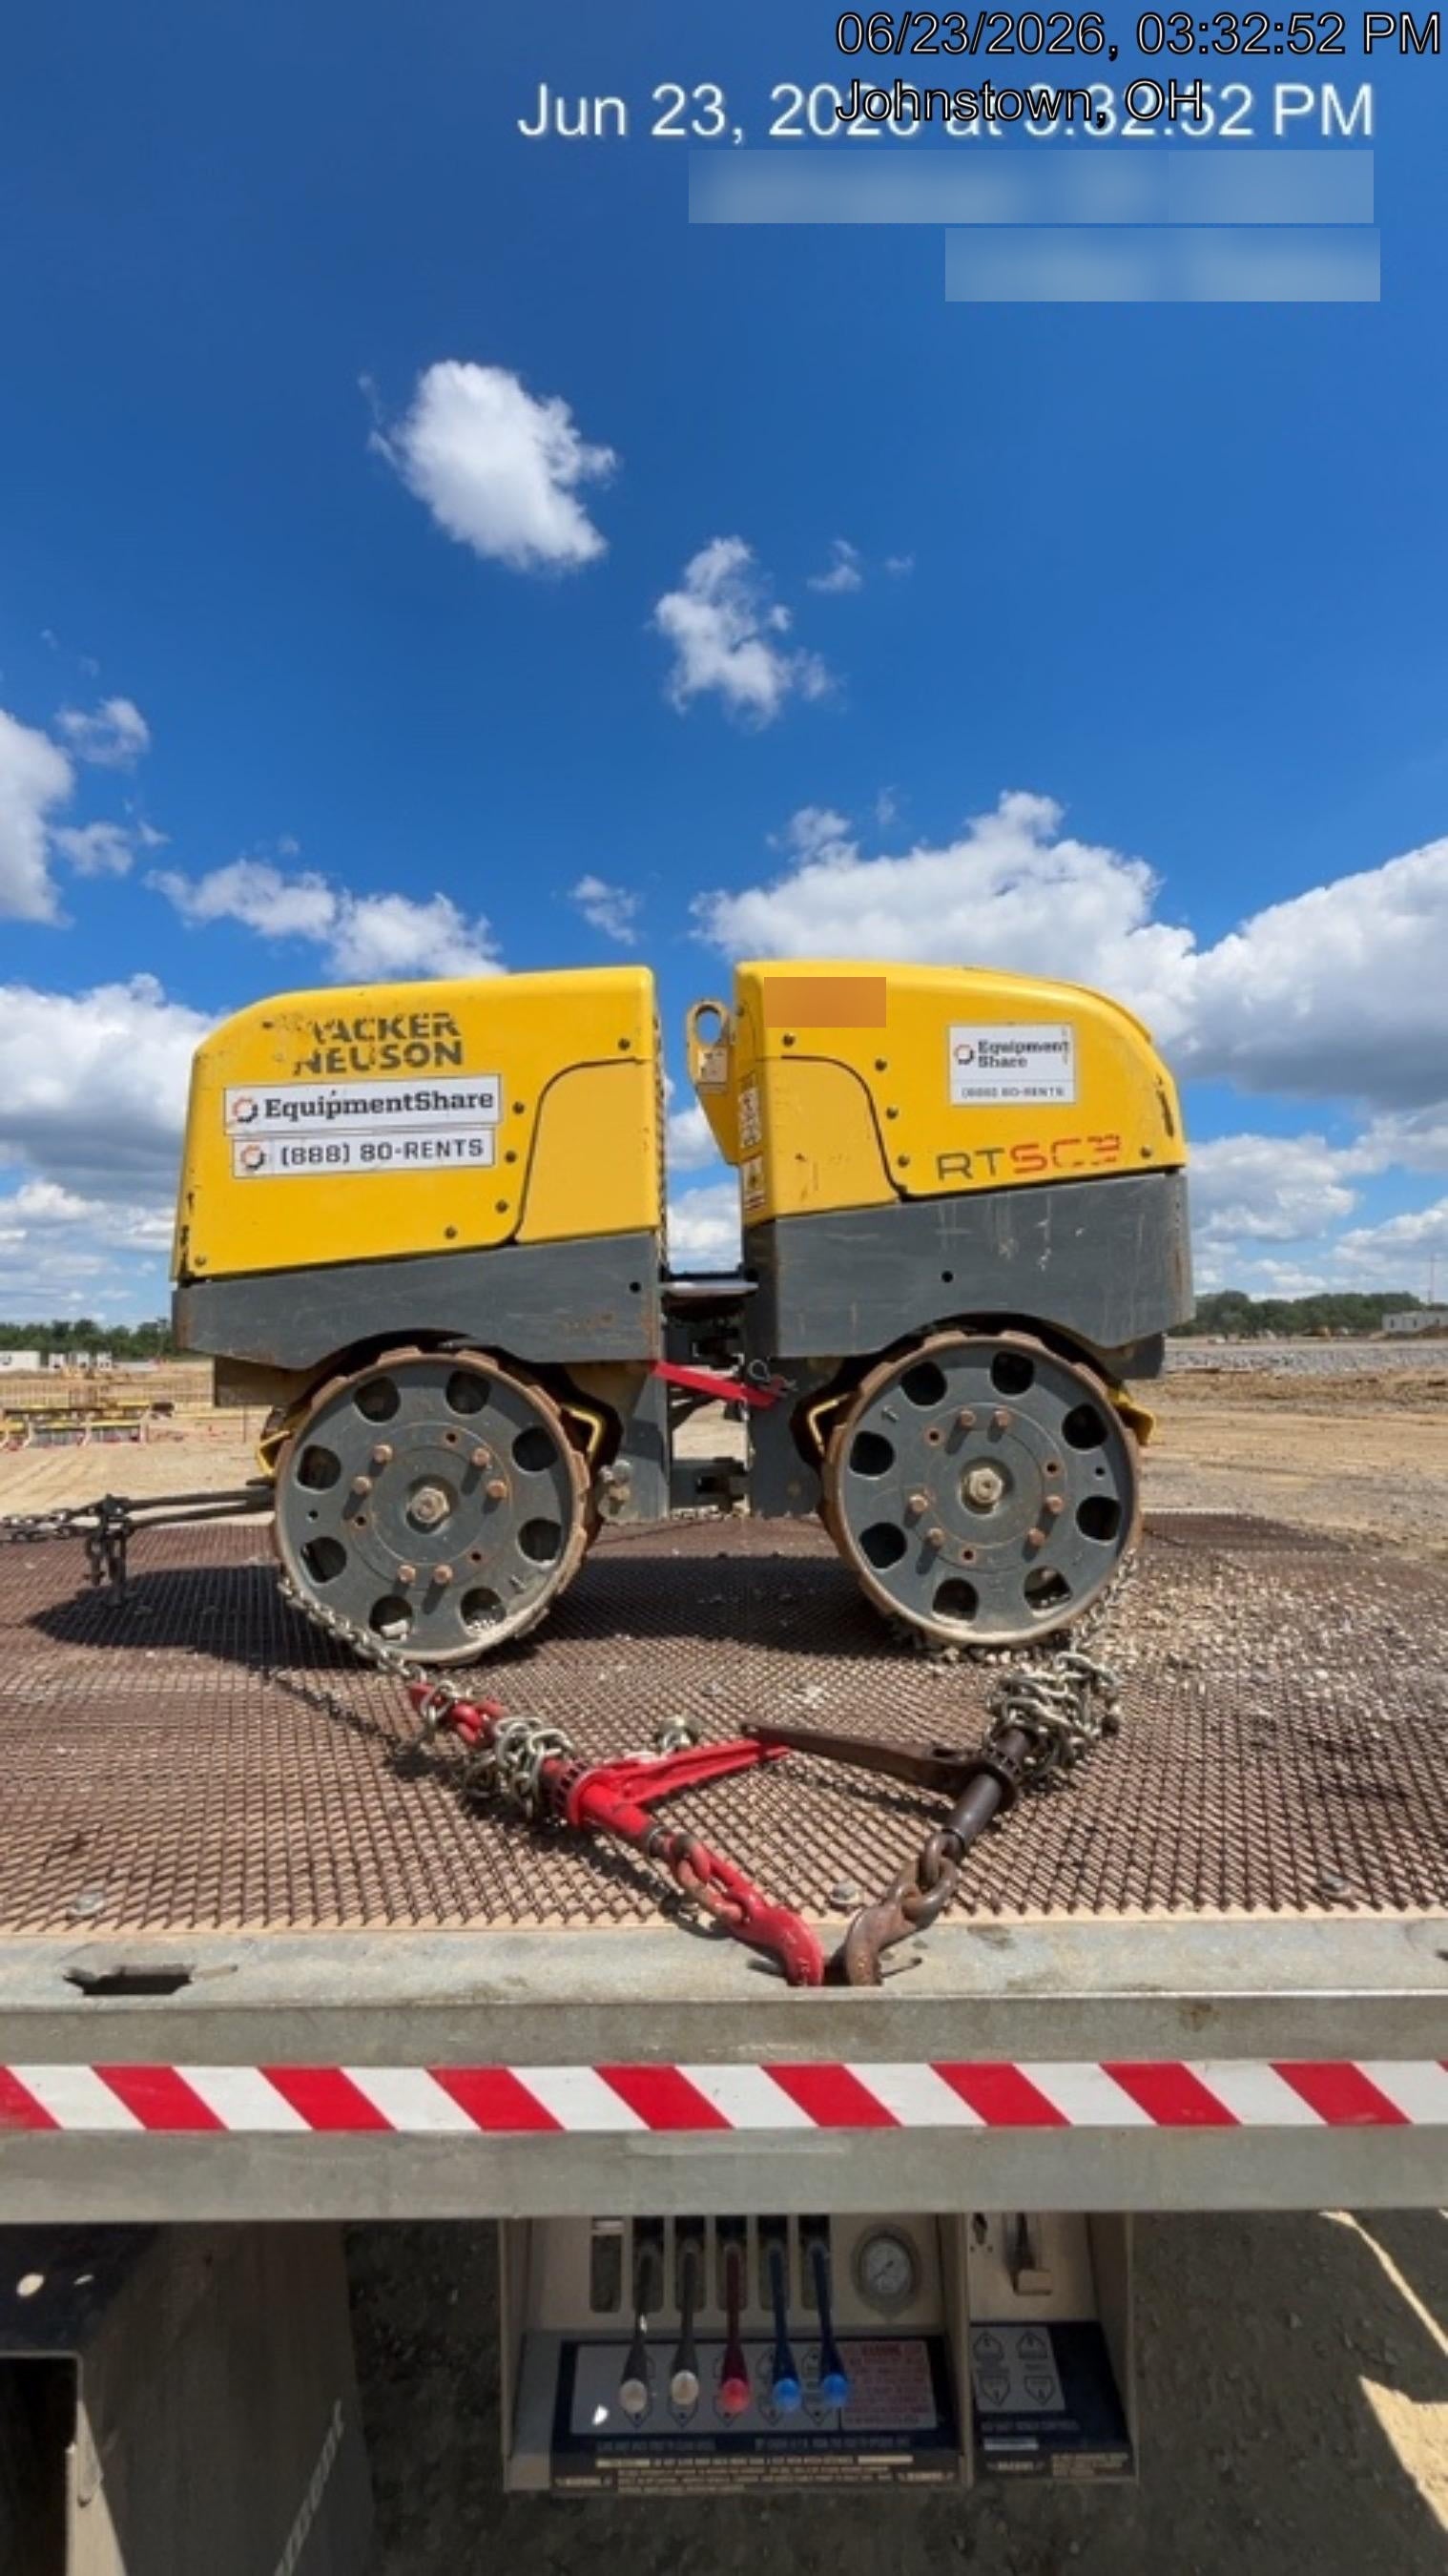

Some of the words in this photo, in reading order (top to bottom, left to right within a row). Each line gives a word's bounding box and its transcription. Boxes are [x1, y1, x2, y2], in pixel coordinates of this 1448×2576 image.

[978, 1039, 1068, 1055] Equipment
[978, 1055, 1028, 1069] Share
[264, 1091, 494, 1121] EquipmentShare
[281, 1144, 350, 1166] (888)
[360, 1138, 485, 1163] 80-RENTS
